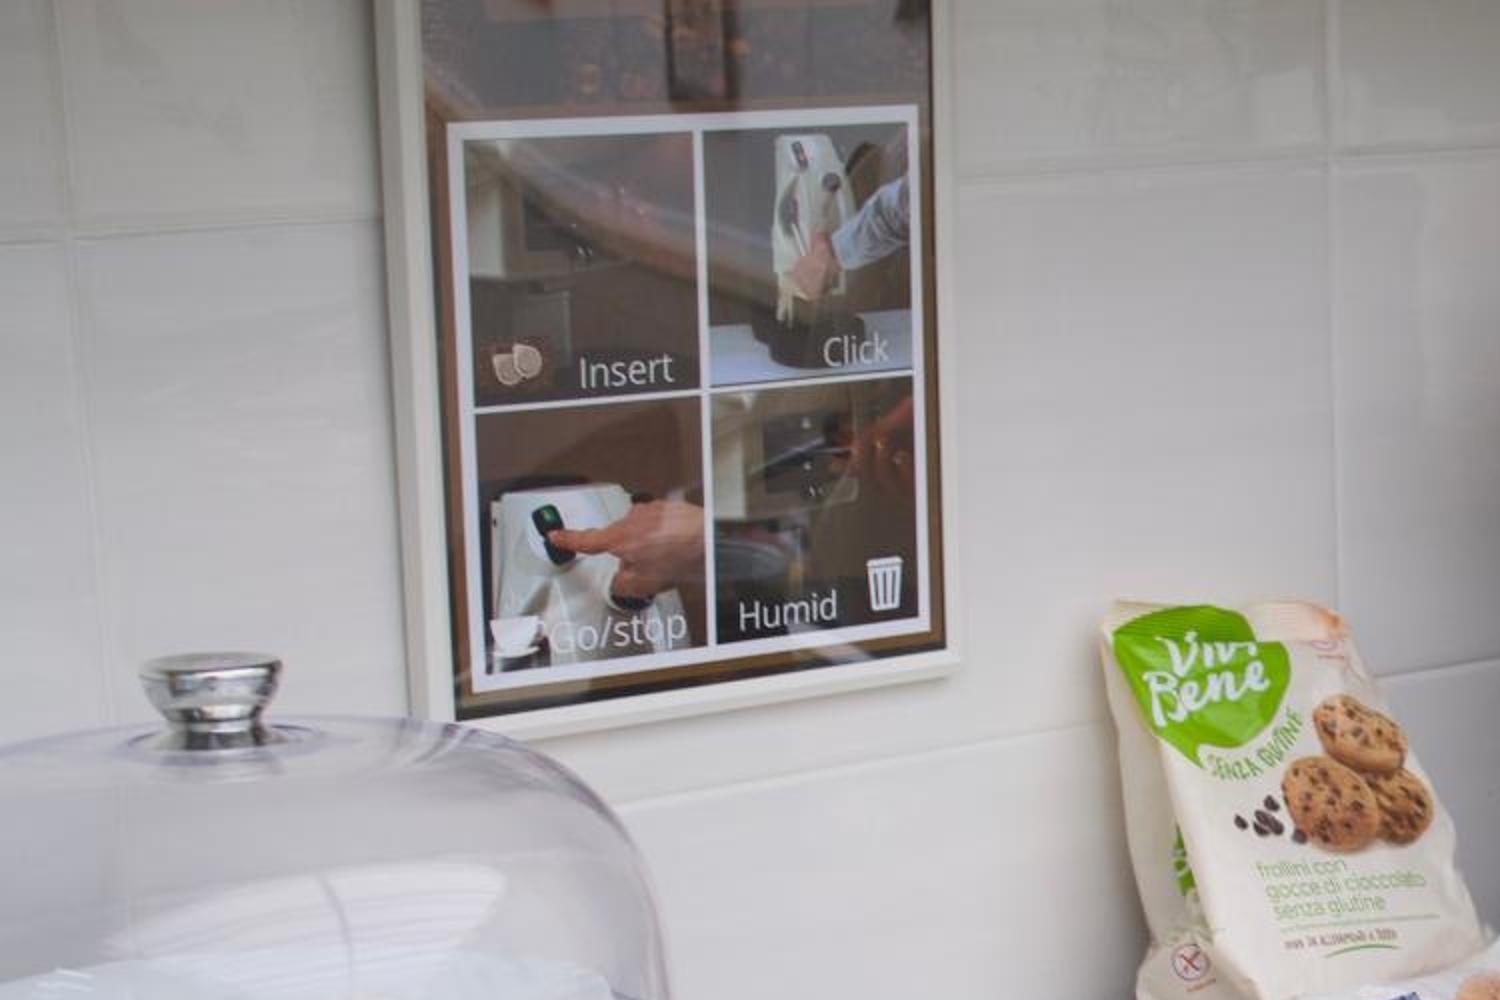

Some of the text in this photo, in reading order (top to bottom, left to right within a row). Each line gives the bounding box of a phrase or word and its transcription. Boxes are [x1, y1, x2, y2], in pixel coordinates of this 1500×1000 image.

[823, 332, 889, 367] Click
[579, 353, 675, 389] Insert
[740, 590, 837, 632] Humid
[551, 613, 688, 655] Go/stop
[1142, 660, 1271, 728] Bene
[1313, 858, 1346, 875] con
[1265, 879, 1322, 904] gocce
[1324, 877, 1343, 895] di
[1273, 894, 1387, 921] senza glutine
